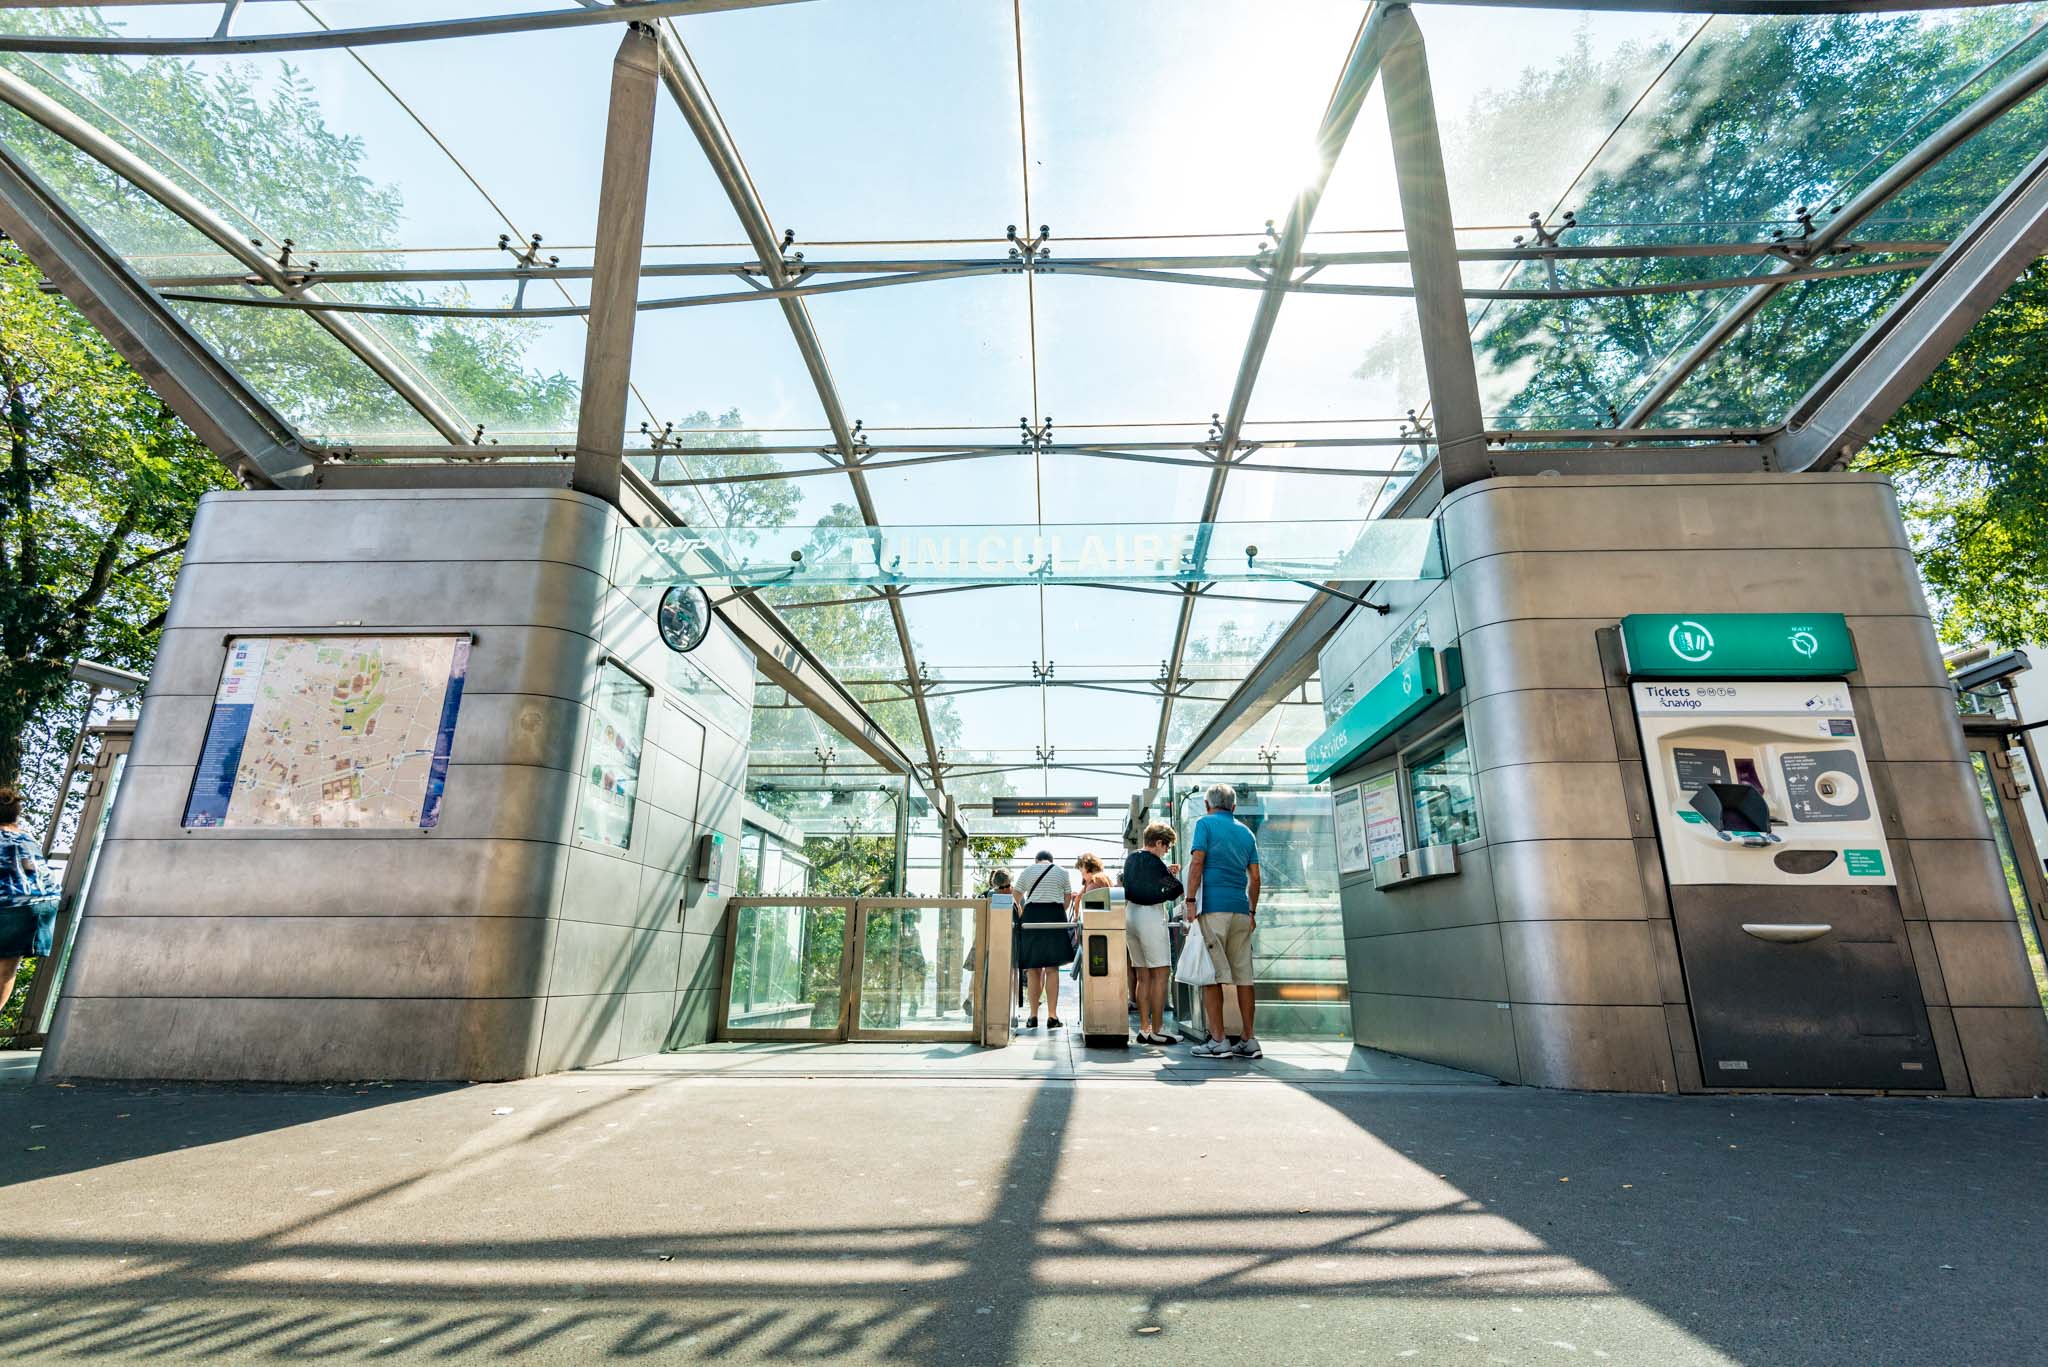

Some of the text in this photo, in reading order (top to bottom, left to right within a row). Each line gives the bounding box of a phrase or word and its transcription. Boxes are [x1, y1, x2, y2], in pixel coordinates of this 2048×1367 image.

[853, 534, 1197, 575] FUNICULAIRE
[1645, 686, 1691, 697] Tickets
[1661, 697, 1702, 709] navigo
